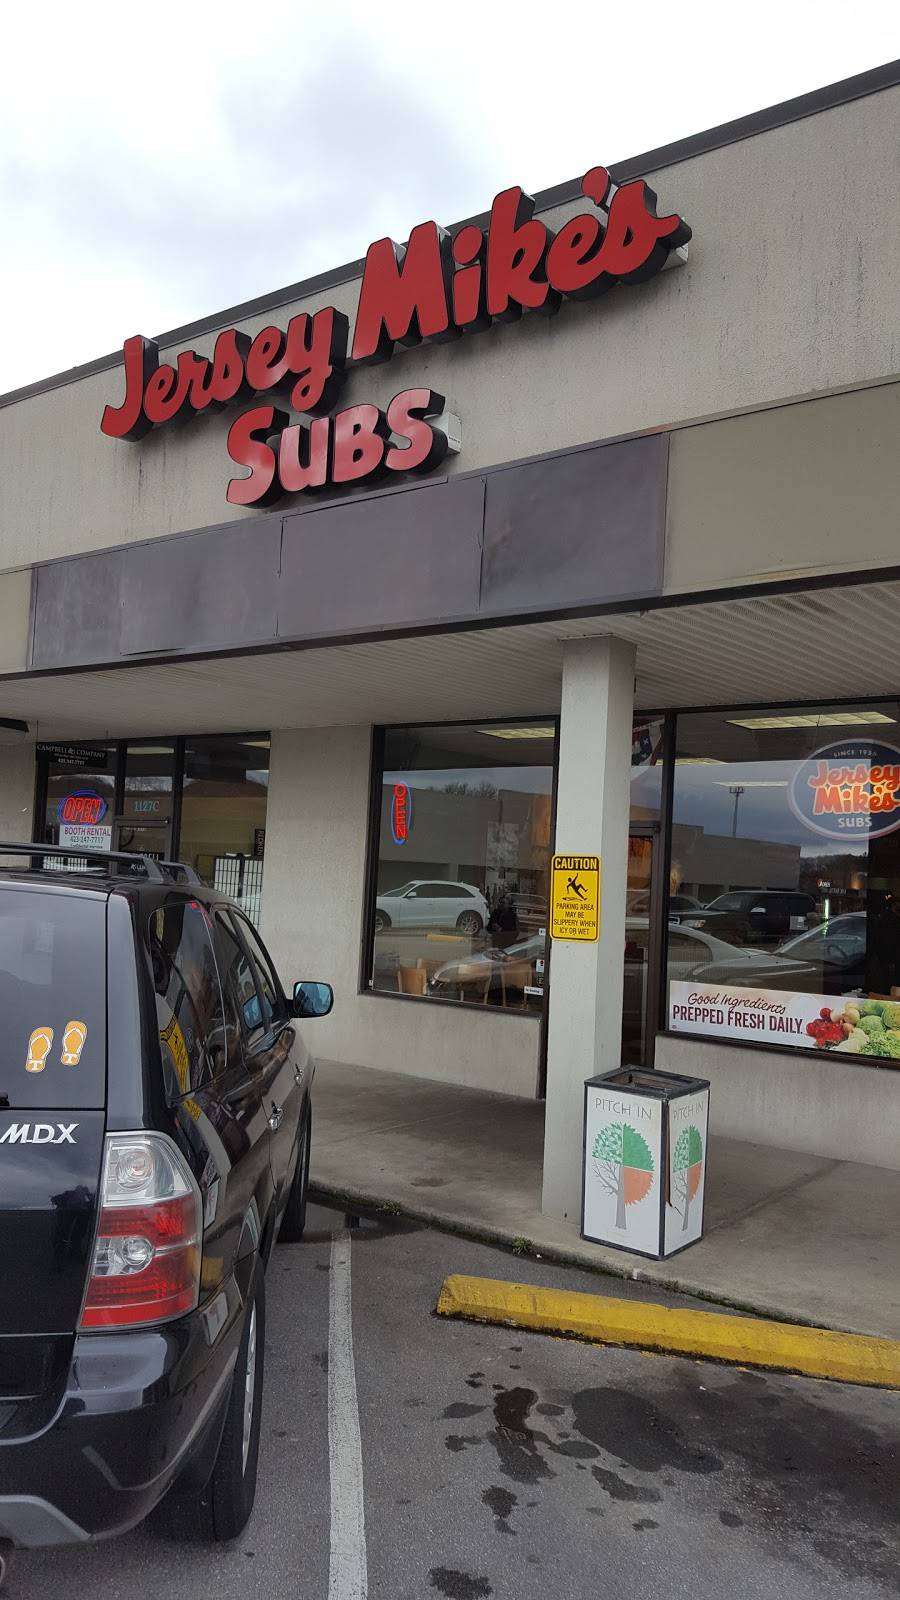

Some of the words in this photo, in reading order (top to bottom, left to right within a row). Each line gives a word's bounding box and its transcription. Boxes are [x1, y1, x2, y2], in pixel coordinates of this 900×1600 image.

[100, 334, 345, 441] Jersey
[351, 165, 686, 363] Mike's
[225, 386, 438, 508] SUBS
[807, 759, 900, 792] Jersey
[63, 797, 101, 823] OPEN
[135, 800, 160, 812] 1127C
[812, 783, 900, 816] Mike's
[394, 783, 407, 839] OPEN
[838, 816, 873, 828] SUBS
[64, 826, 86, 836] BOOTH
[86, 827, 111, 837] RENTAL
[554, 857, 598, 870] CAUTION
[556, 902, 579, 911] PARKING
[580, 903, 595, 911] AREA
[553, 918, 579, 927] SLIPPERY
[579, 920, 596, 928] WHEN
[568, 927, 576, 935] OR
[577, 928, 590, 936] WET
[687, 992, 721, 1006] Good
[720, 993, 787, 1015] Ingredients
[672, 1005, 724, 1025] PREPPED
[727, 1010, 765, 1030] FRESH
[769, 1015, 804, 1035] DAILY.
[595, 1097, 632, 1116] PITCH
[637, 1106, 652, 1120] IN
[673, 1105, 694, 1120] PITCH
[695, 1101, 704, 1113] IN
[0, 1123, 80, 1144] MDX
